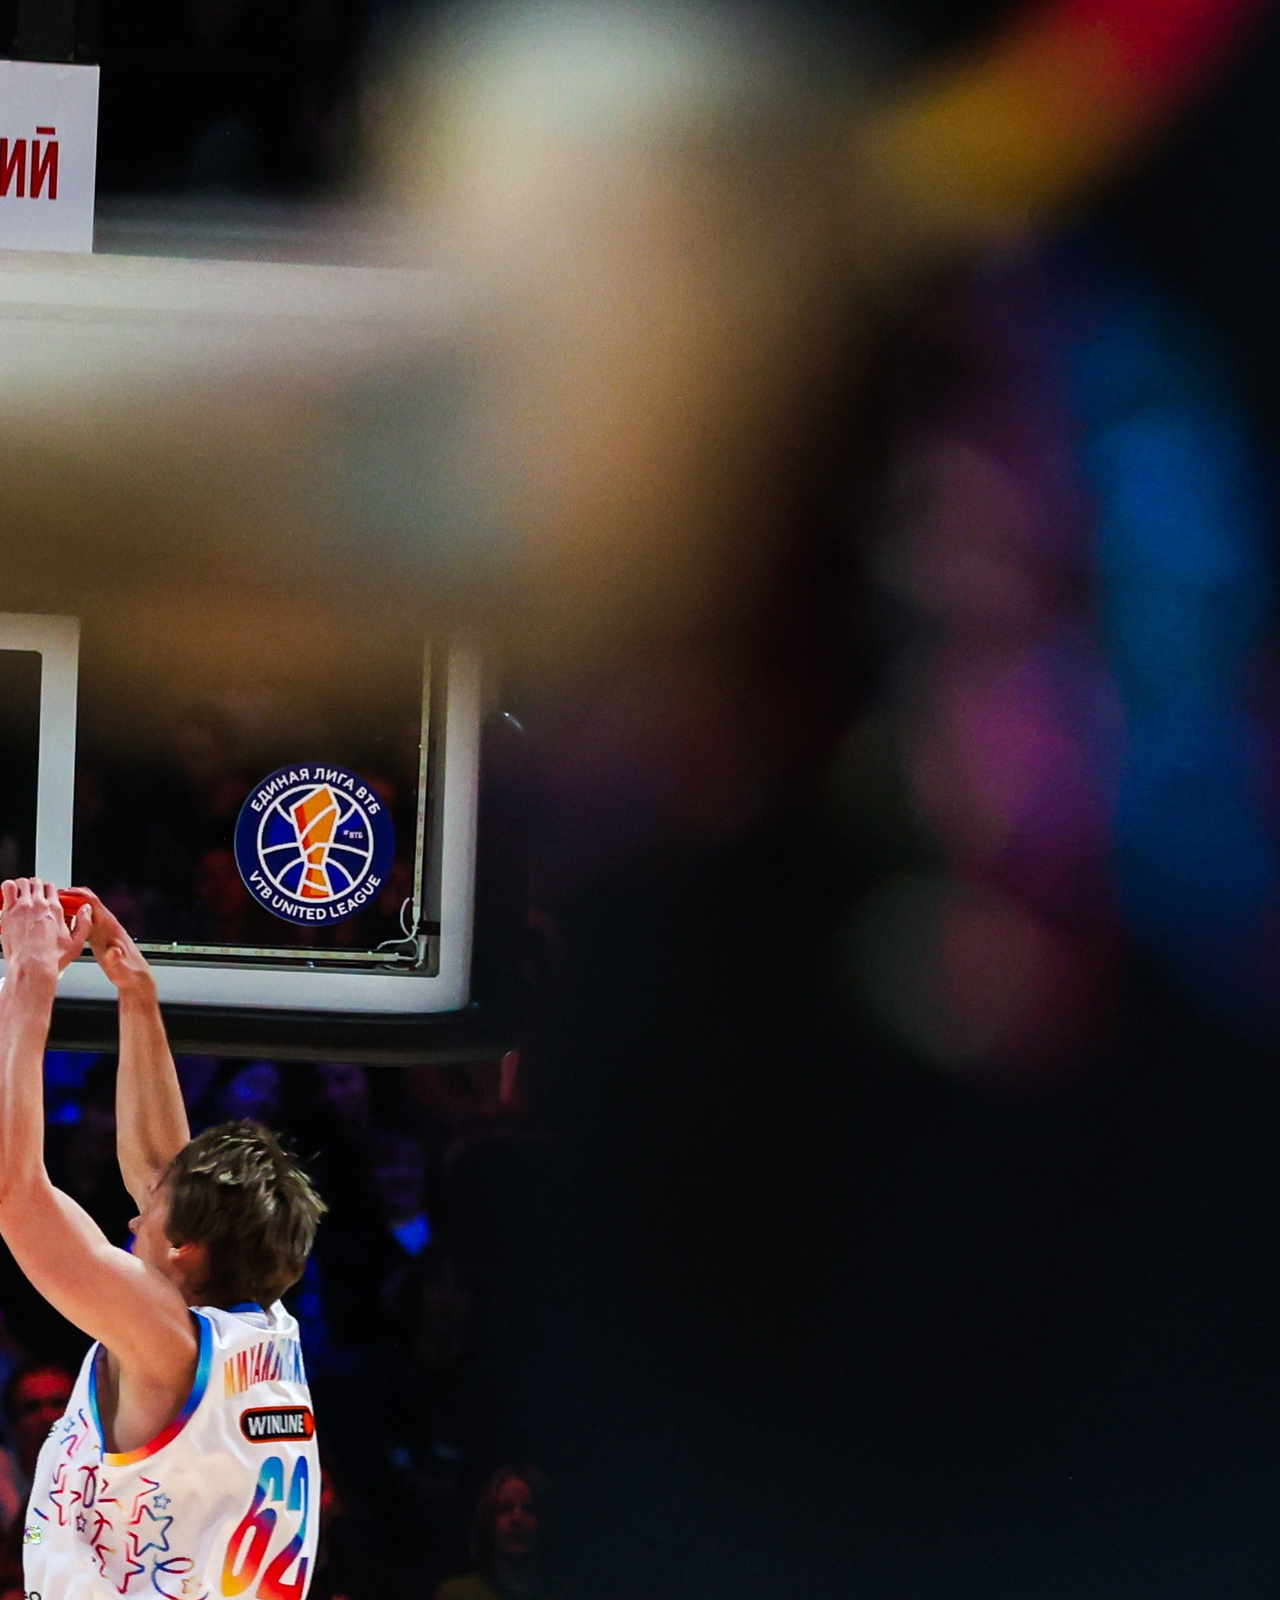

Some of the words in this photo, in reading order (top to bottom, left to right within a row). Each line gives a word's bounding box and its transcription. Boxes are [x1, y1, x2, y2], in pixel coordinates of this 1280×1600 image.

[250, 768, 310, 813] ЕДИНАЯ
[312, 767, 355, 791] ЛИГА
[355, 786, 382, 816] ВТБ
[249, 869, 274, 900] VTB
[271, 895, 327, 921] UNITED
[328, 873, 382, 919] LEAGUE
[247, 1413, 305, 1437] WINLINE
